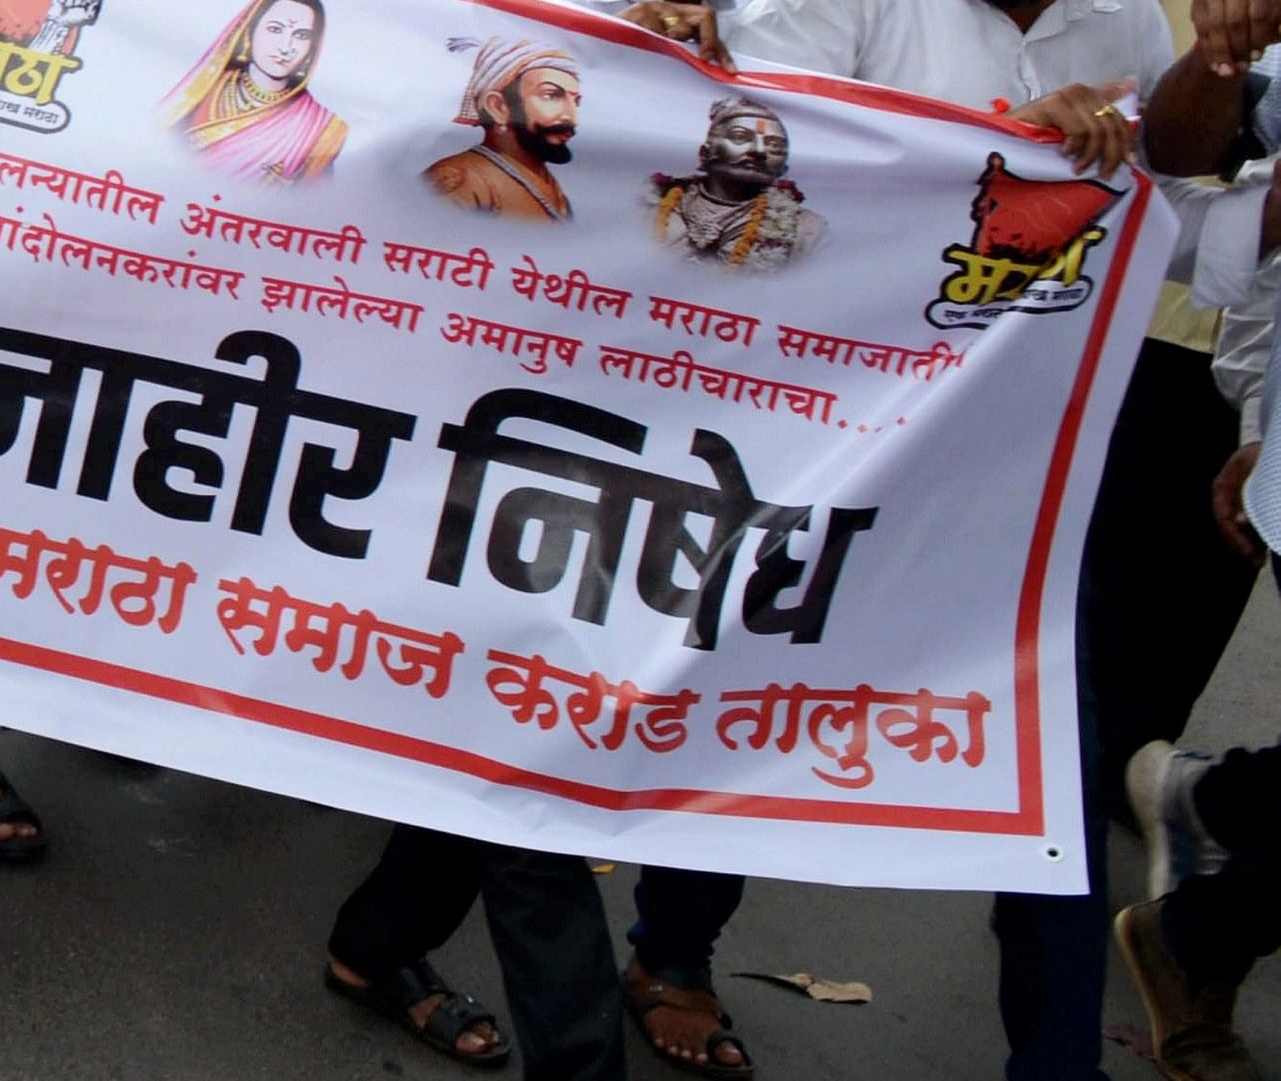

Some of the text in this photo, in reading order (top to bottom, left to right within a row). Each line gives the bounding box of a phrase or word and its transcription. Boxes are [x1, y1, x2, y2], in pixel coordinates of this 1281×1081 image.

[180, 194, 368, 265] अंतरवाली
[382, 240, 496, 289] सराटी
[511, 254, 633, 320] येथील
[648, 295, 762, 348] मराठा
[261, 274, 425, 332] झालेल्या
[440, 311, 583, 375] अमानुष
[426, 387, 880, 652] निषेध
[217, 576, 465, 699] समाज
[485, 647, 701, 753] कराड
[718, 682, 993, 790] तालुका
